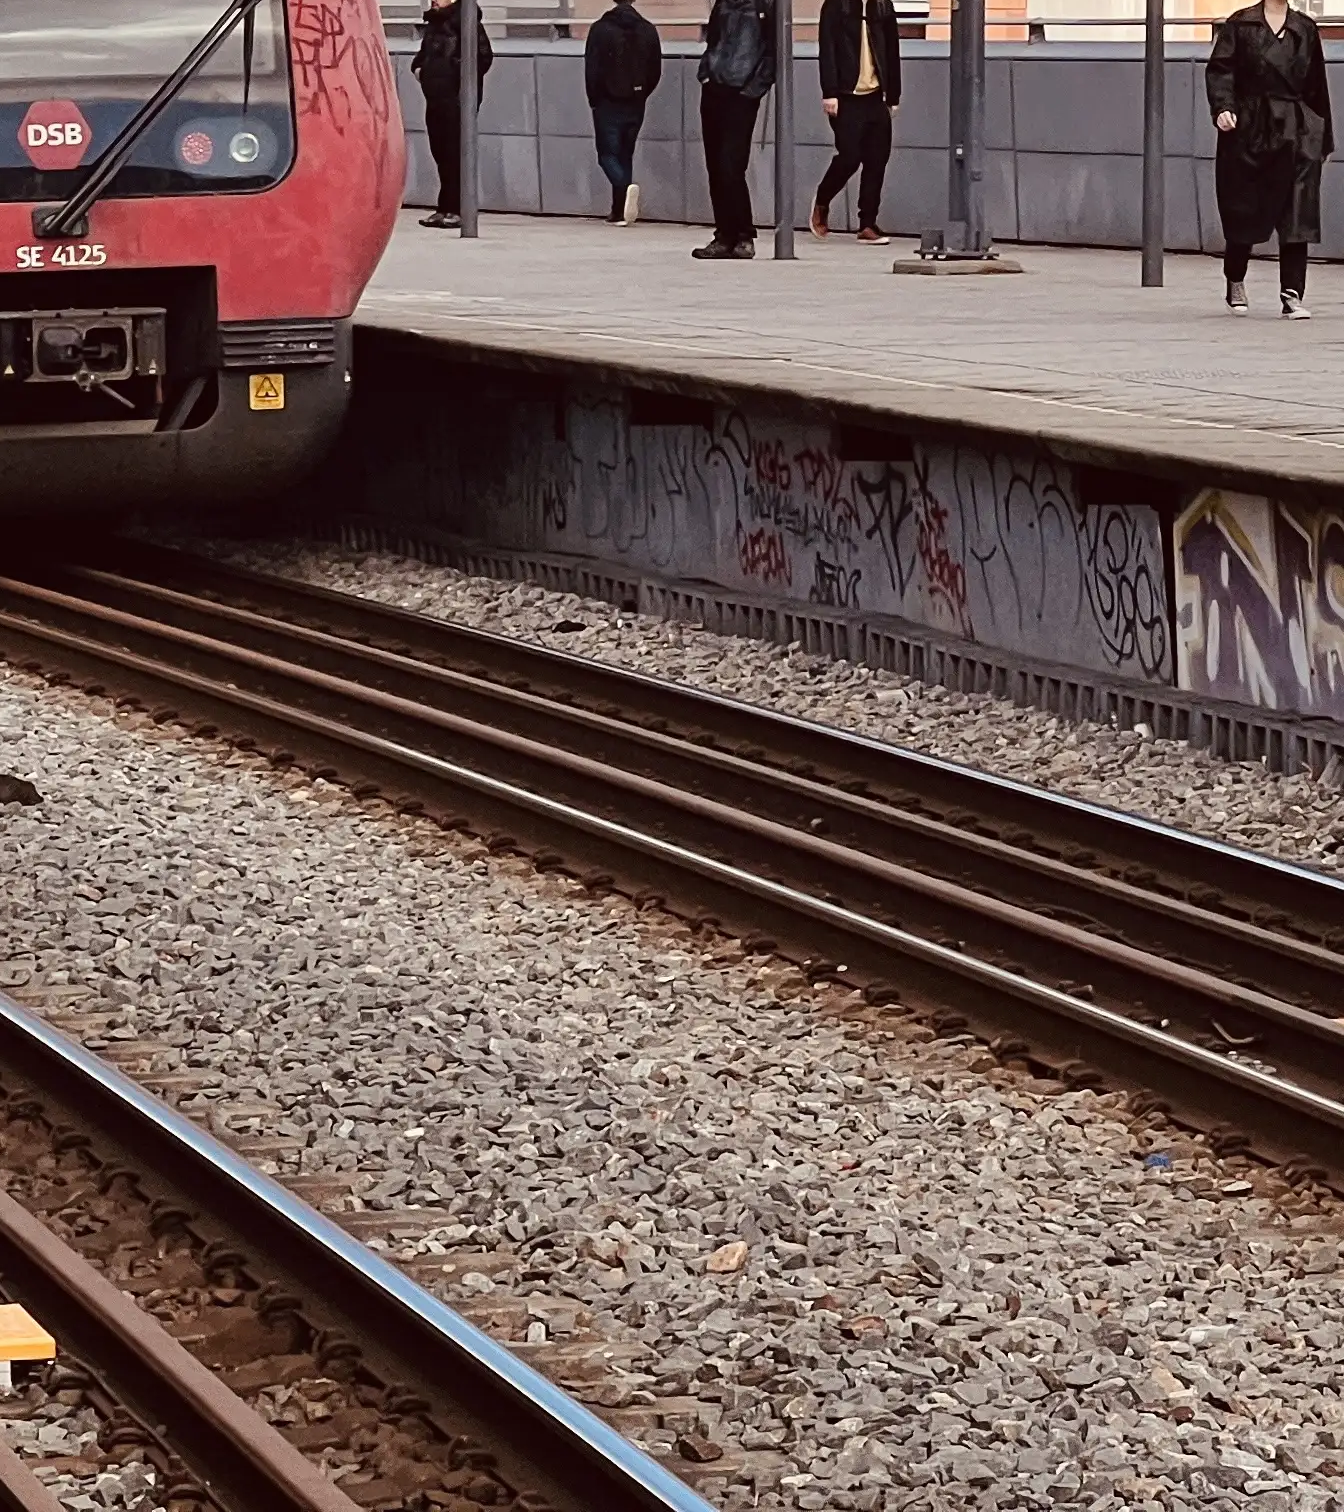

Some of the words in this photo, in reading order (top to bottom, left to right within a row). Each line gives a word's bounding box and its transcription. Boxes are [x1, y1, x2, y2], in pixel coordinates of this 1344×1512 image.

[26, 122, 84, 147] DSB
[16, 245, 45, 269] SE
[51, 244, 107, 267] 4125
